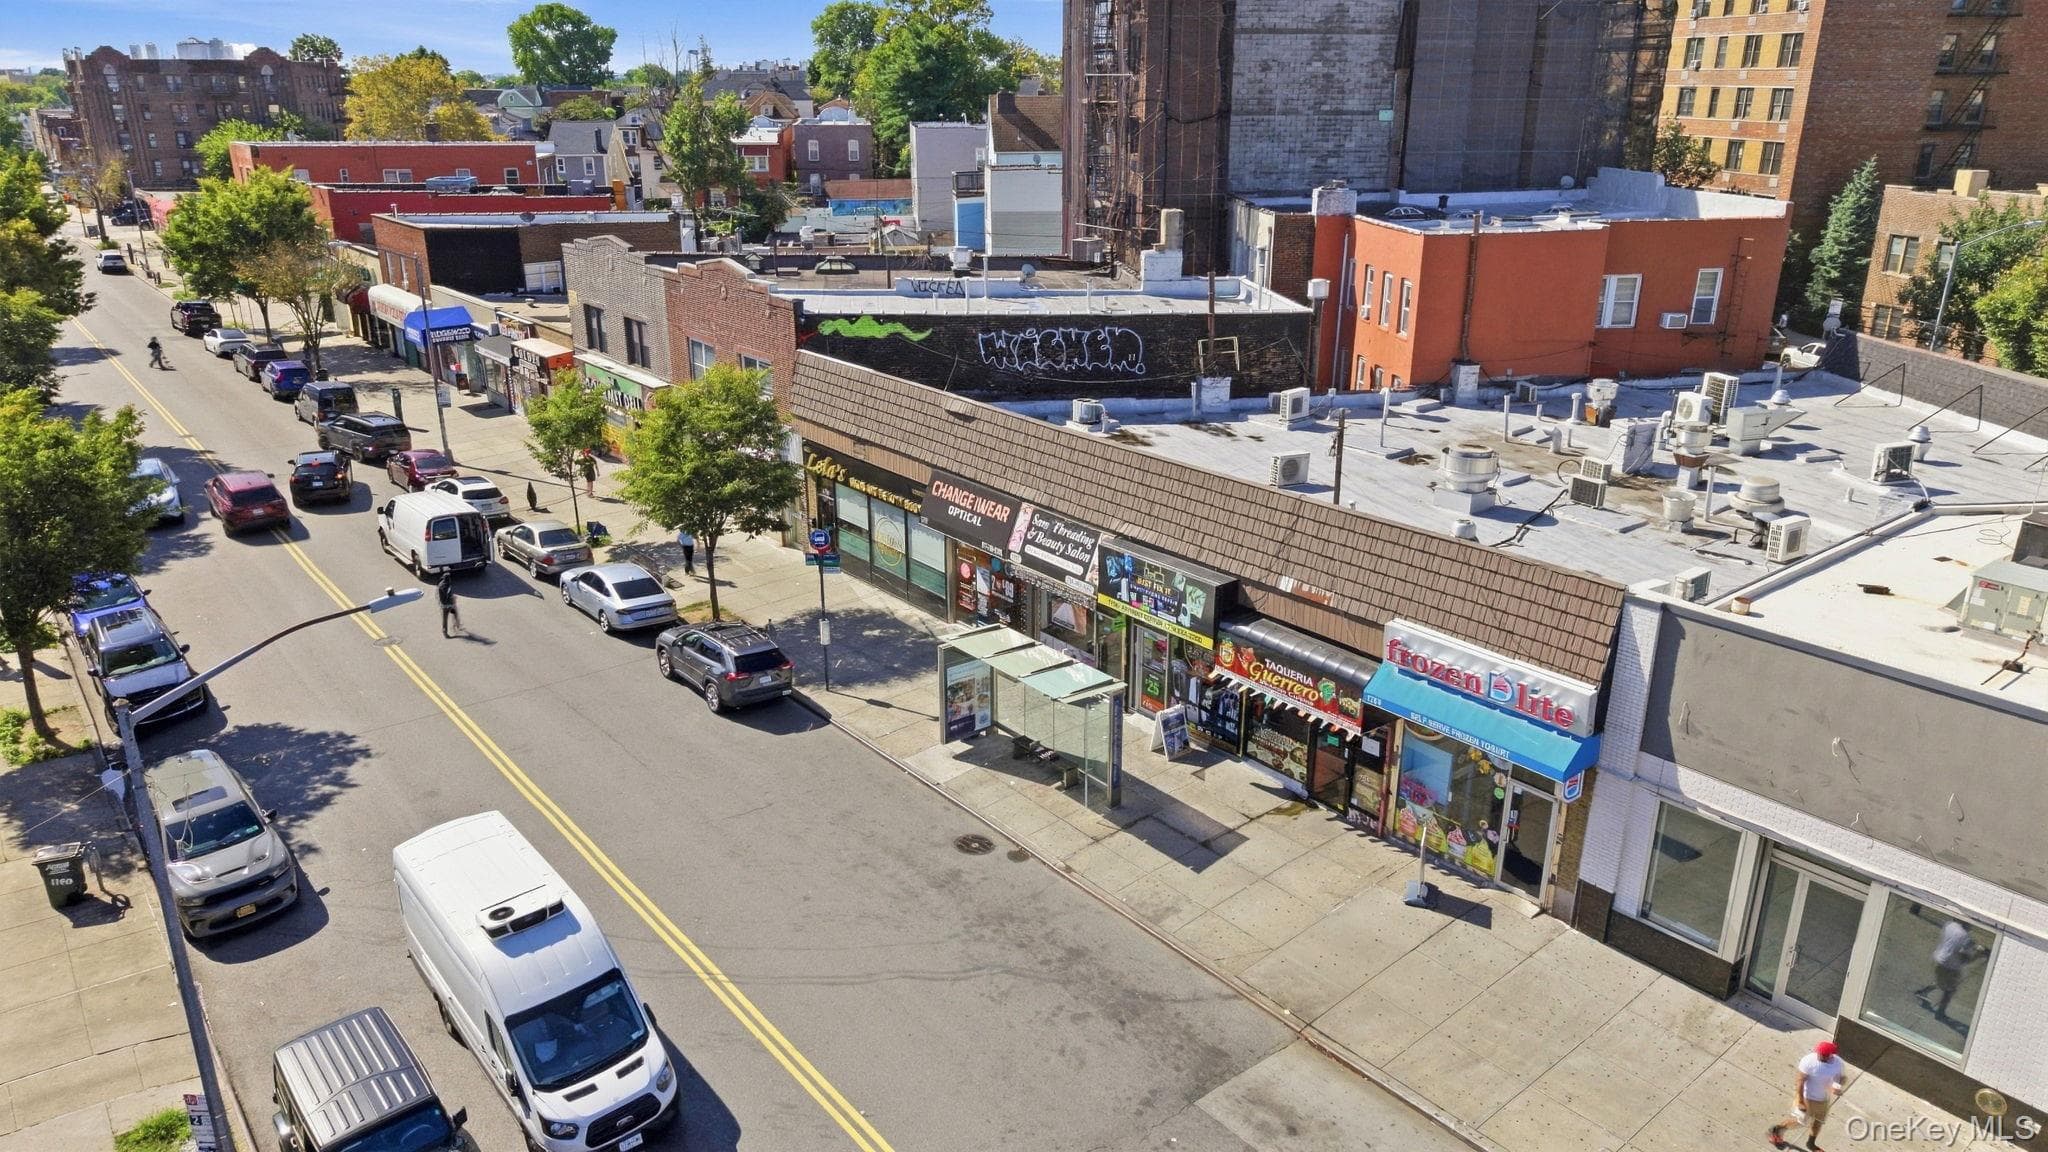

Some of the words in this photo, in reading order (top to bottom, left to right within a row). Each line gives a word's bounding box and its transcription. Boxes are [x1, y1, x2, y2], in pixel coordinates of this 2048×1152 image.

[947, 505, 982, 527] OPTICAL
[1035, 531, 1066, 555] Beauty
[1065, 543, 1091, 563] Salon
[1053, 521, 1095, 550] Threading
[1265, 658, 1314, 687] TAQUERIA
[1386, 637, 1484, 696] frozen
[1249, 662, 1319, 702] Guerrero
[1451, 728, 1480, 746] FROZEN
